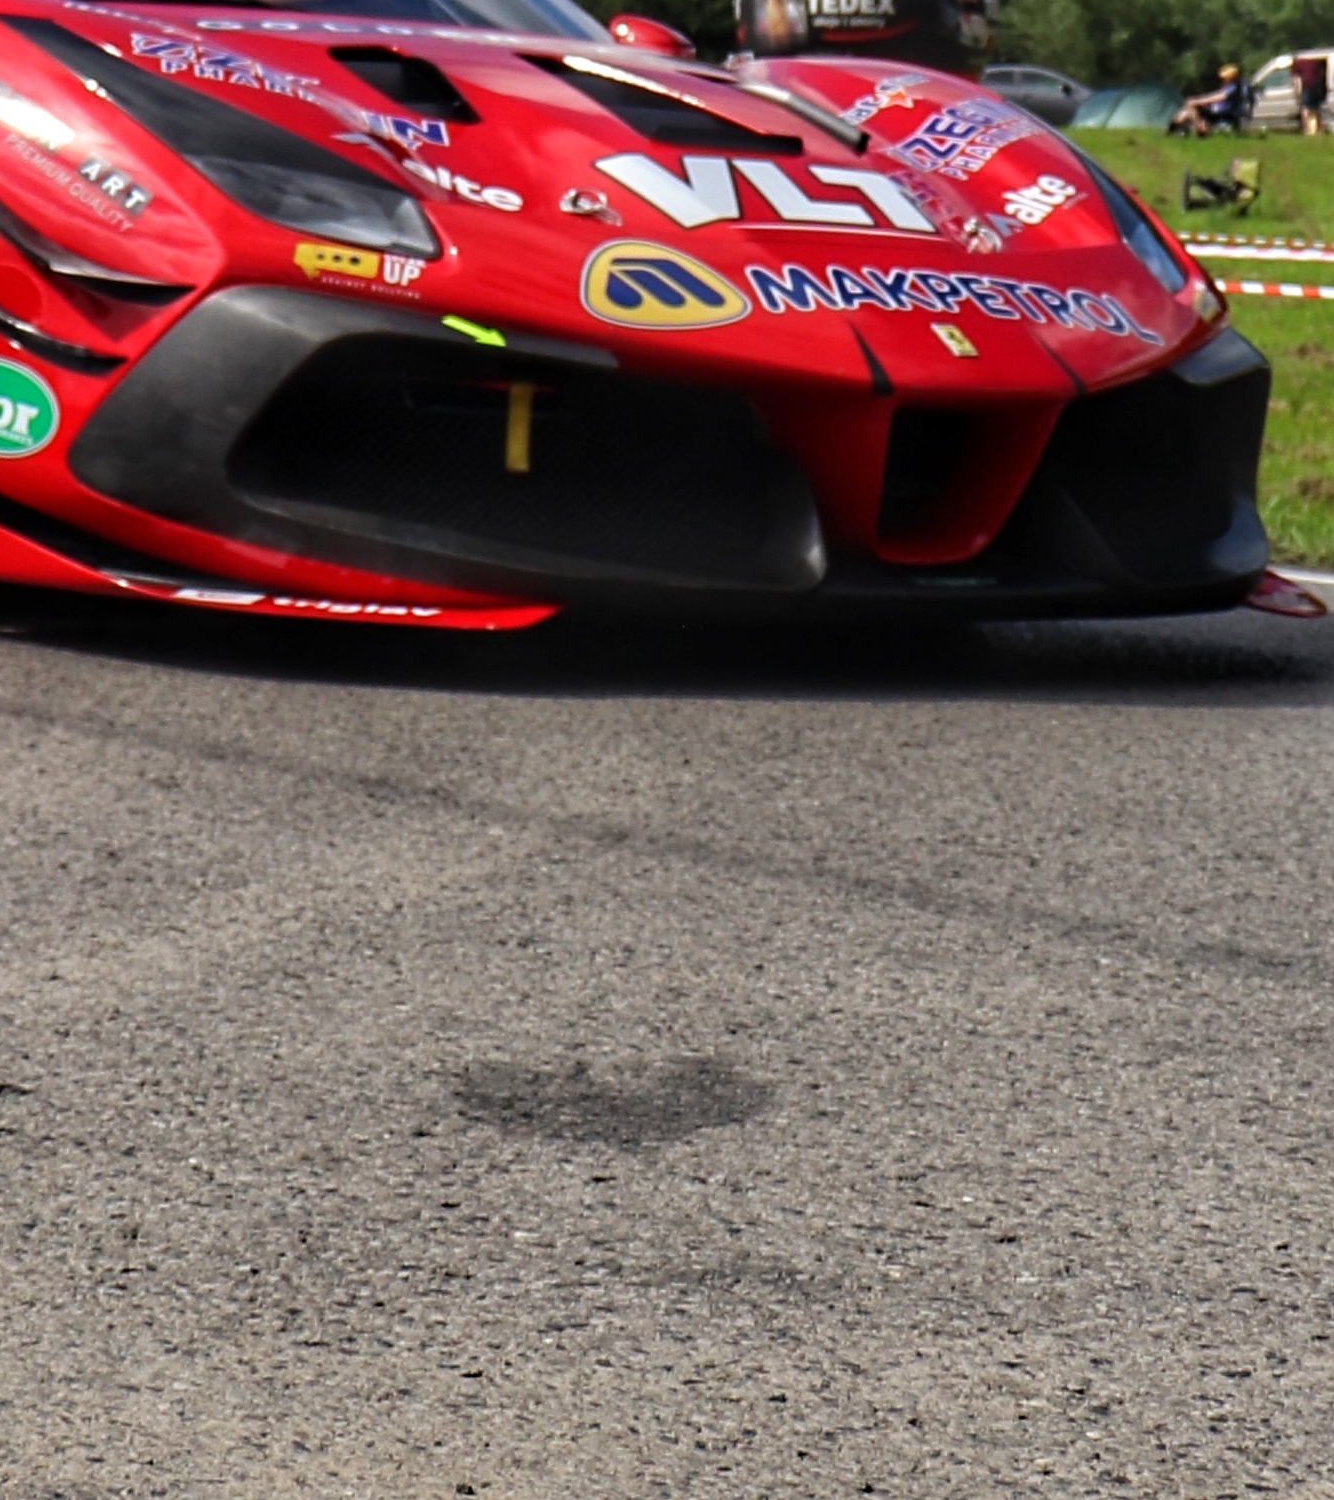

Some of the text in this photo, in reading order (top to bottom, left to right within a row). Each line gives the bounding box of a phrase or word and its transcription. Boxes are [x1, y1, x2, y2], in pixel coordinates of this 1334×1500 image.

[79, 160, 147, 210] ART
[594, 152, 938, 234] VLT
[383, 261, 422, 288] UP
[743, 263, 1165, 347] MAKPETROL
